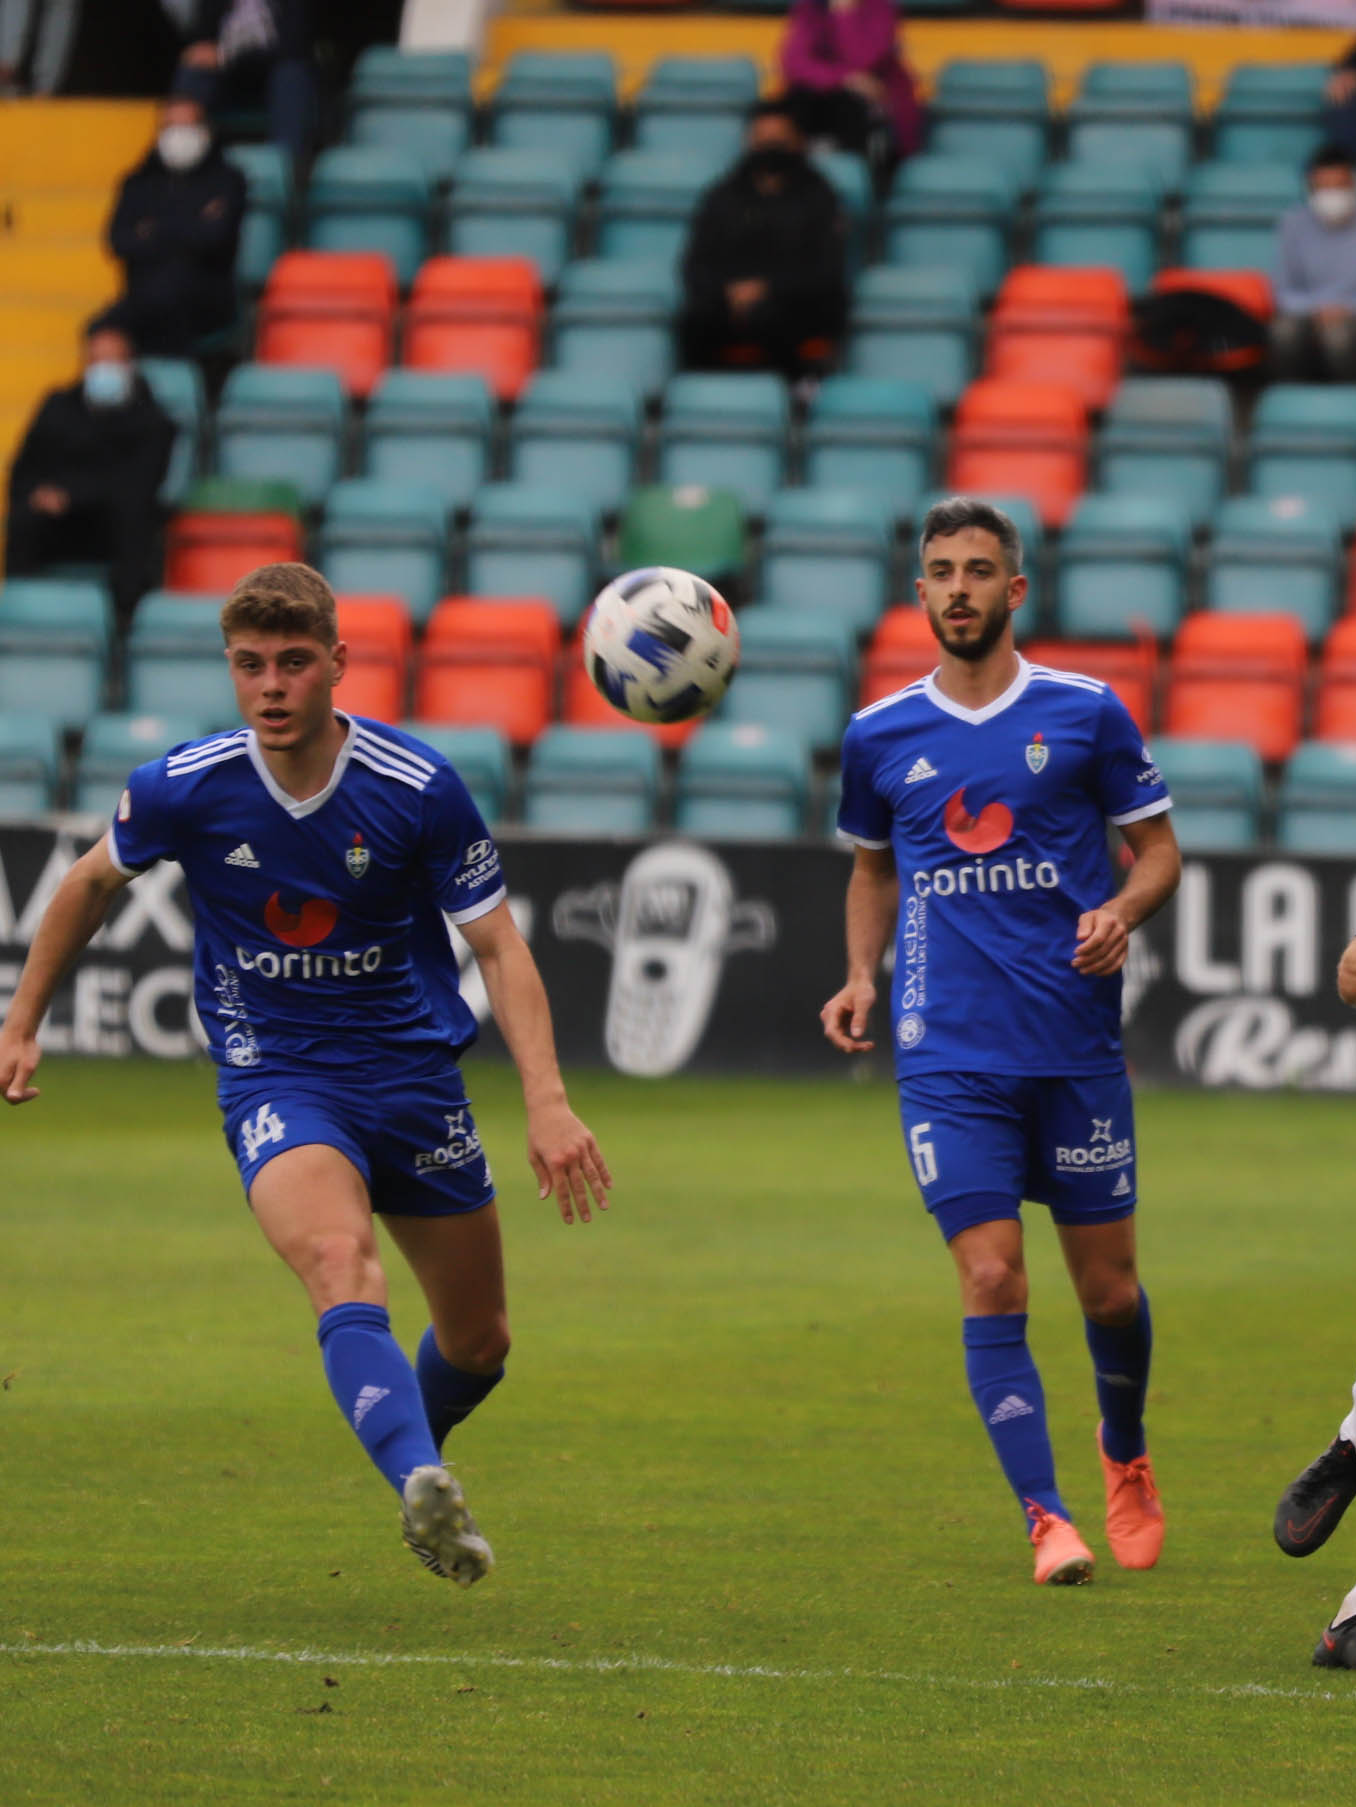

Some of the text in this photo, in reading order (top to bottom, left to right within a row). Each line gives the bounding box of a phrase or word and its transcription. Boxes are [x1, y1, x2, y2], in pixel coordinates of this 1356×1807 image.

[913, 857, 1060, 898] corinto
[1174, 858, 1320, 999] LA
[235, 945, 381, 979] corinto
[241, 1102, 286, 1163] 14
[910, 1122, 938, 1186] 6
